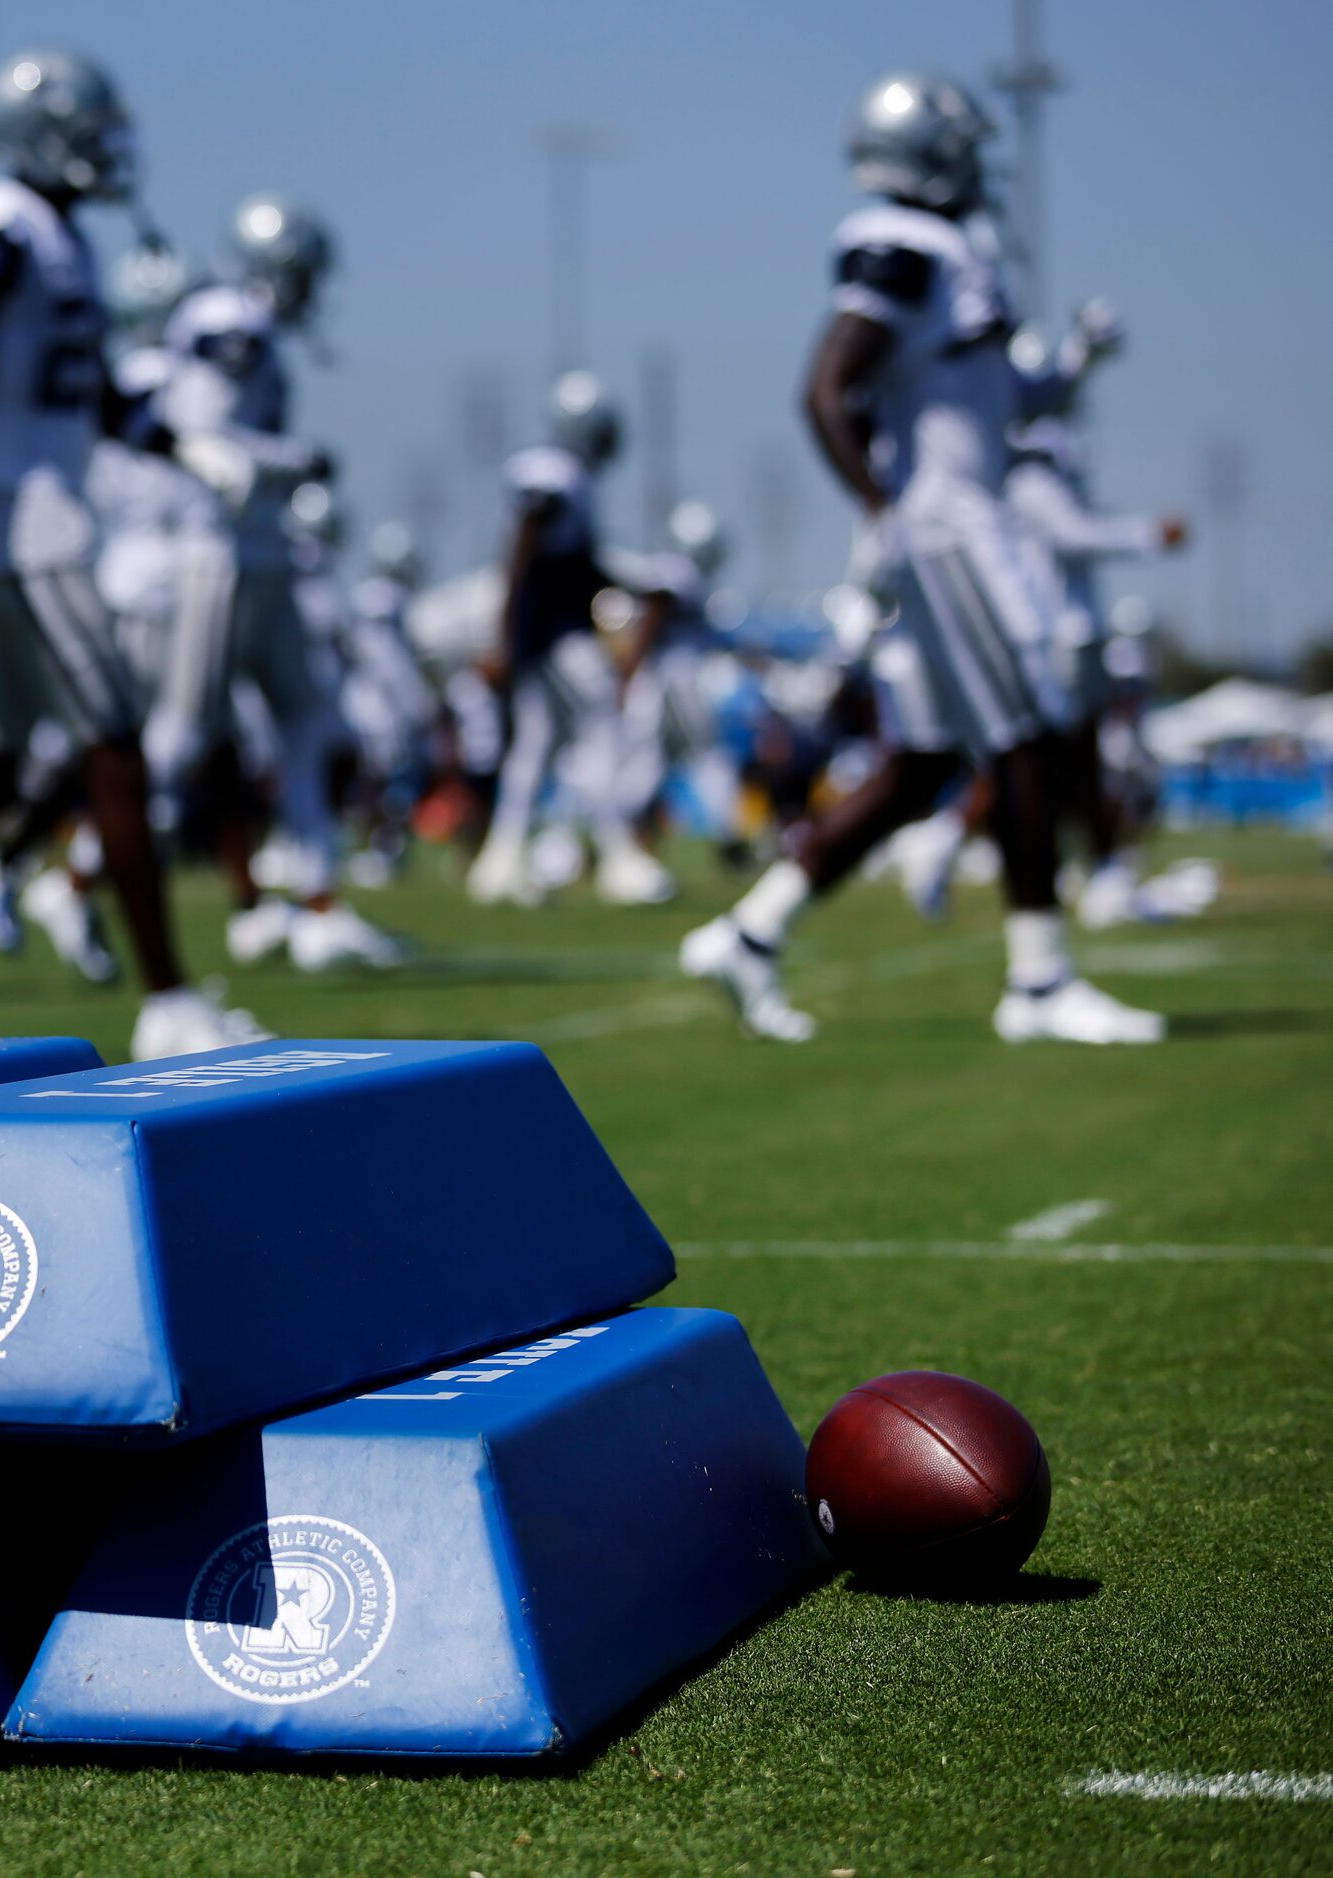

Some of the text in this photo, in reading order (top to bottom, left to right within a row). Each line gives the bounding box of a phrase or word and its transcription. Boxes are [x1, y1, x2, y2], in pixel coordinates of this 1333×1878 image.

[93, 1050, 393, 1087] AGILE
[203, 1530, 378, 1641] ROGERS ATHLETIC COMPANY
[240, 1561, 336, 1655] R
[221, 1652, 339, 1688] ROGERS
